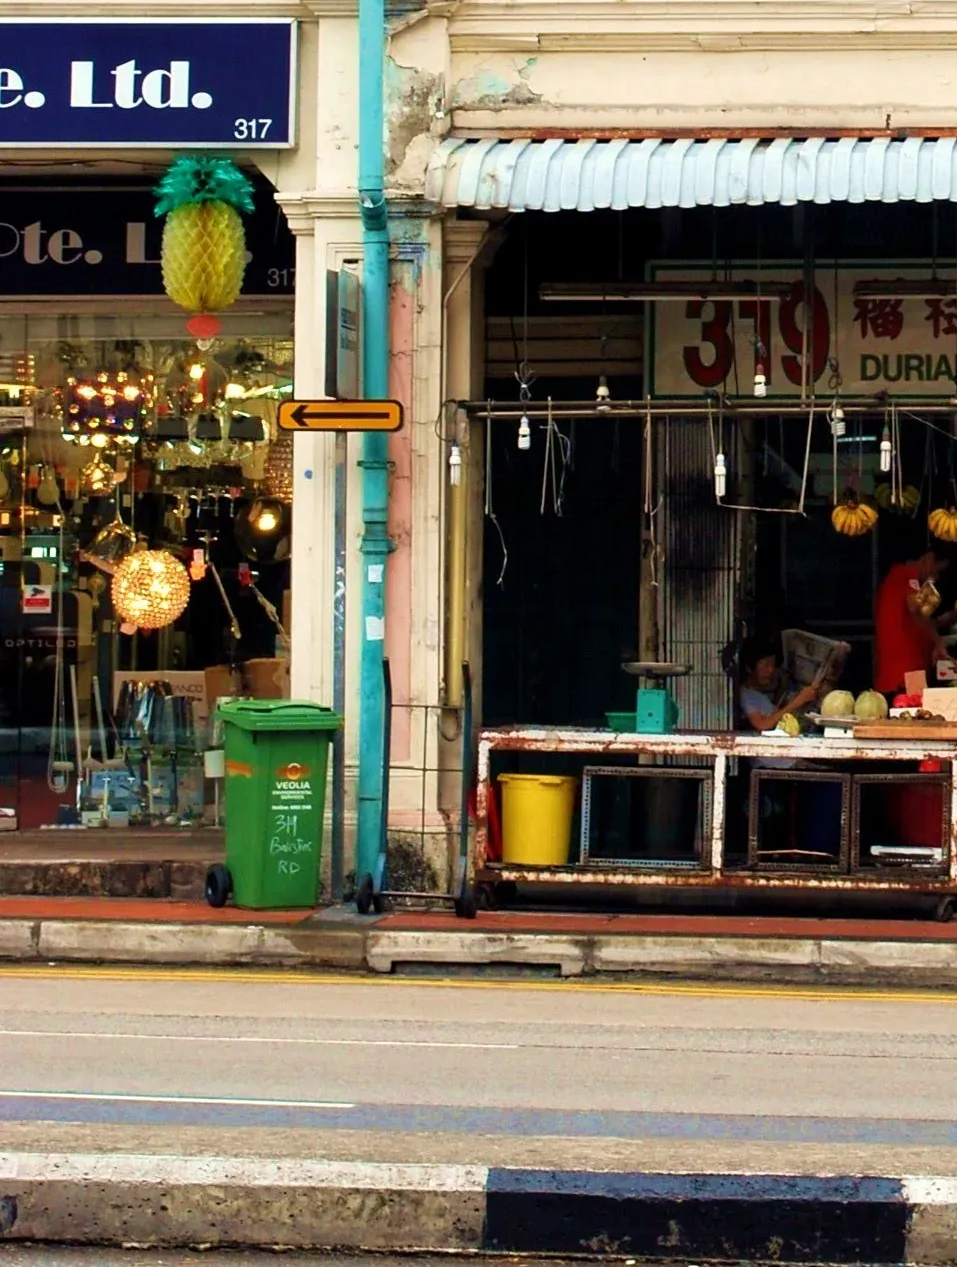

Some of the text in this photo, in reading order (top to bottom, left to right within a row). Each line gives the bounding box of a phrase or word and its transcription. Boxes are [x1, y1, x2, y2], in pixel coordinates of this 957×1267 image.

[70, 59, 213, 109] Ltd.
[234, 118, 273, 139] 317
[683, 281, 831, 387] 319
[4, 638, 77, 648] OPTILD
[275, 781, 311, 790] VEOLIA
[278, 860, 300, 874] RD
